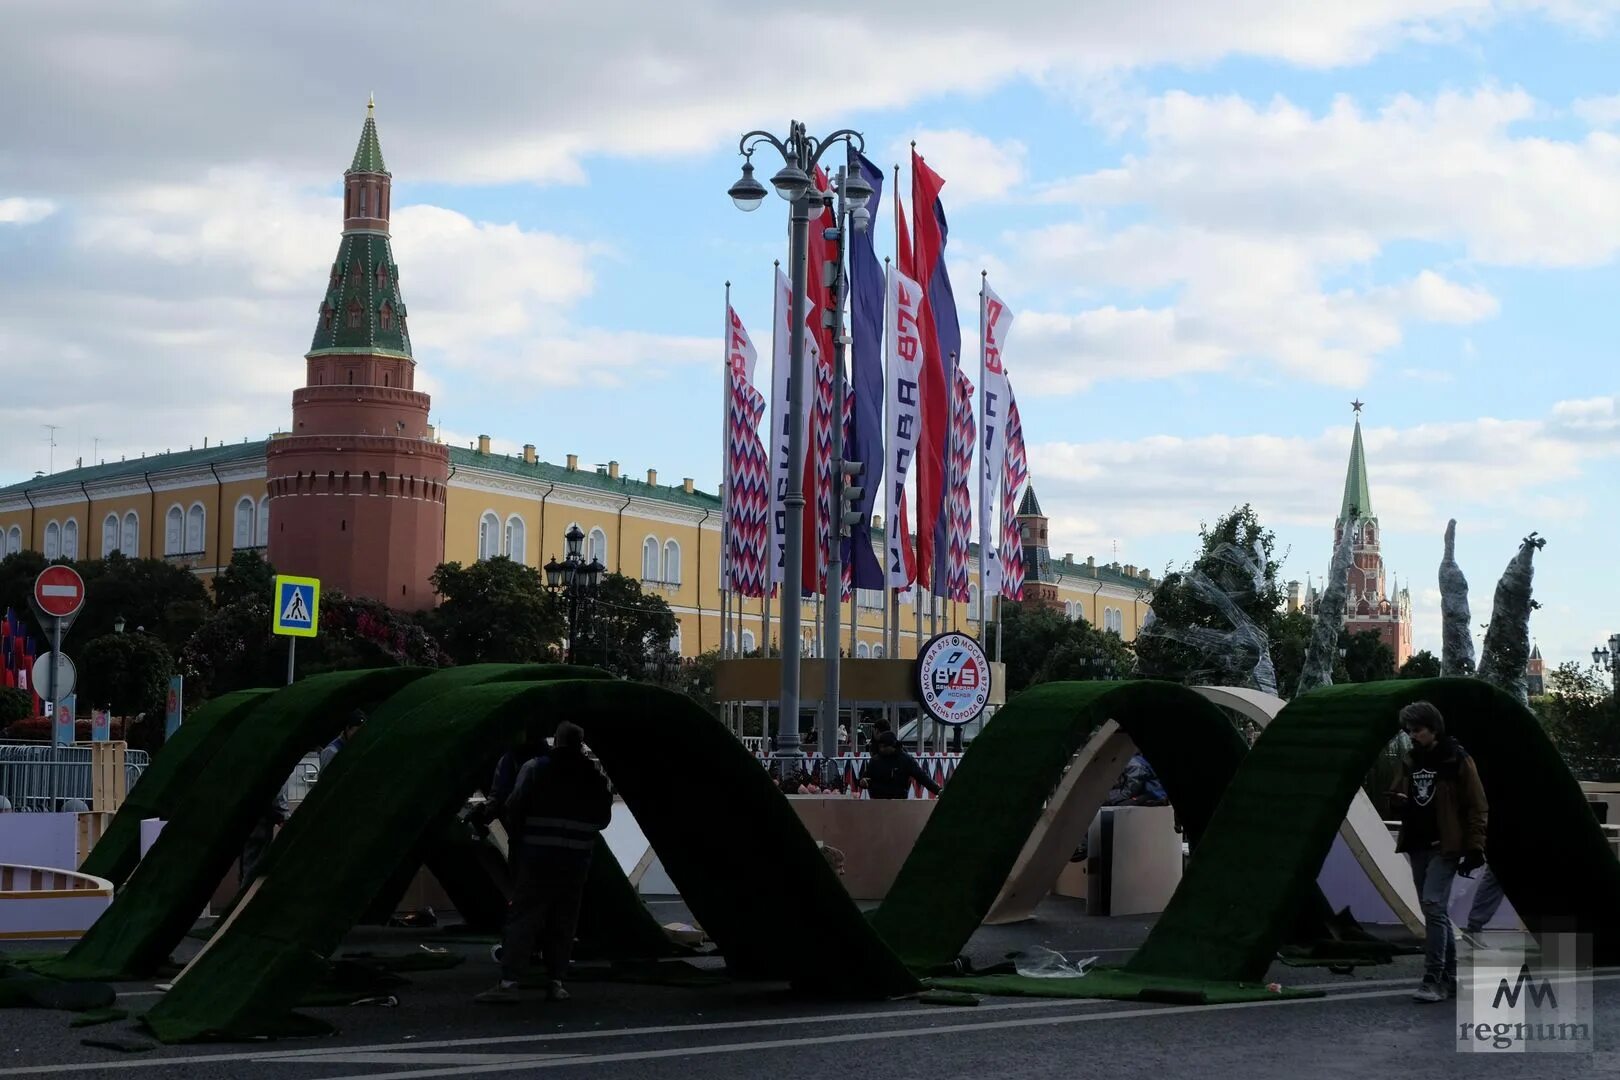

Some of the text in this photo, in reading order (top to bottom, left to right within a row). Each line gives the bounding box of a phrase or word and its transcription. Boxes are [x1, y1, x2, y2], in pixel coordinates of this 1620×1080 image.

[923, 640, 949, 690] МОСКВА 875
[961, 640, 986, 672] МОСКВА
[936, 668, 975, 685] 875
[932, 702, 979, 719] ДЕНЬ ГОРОДА
